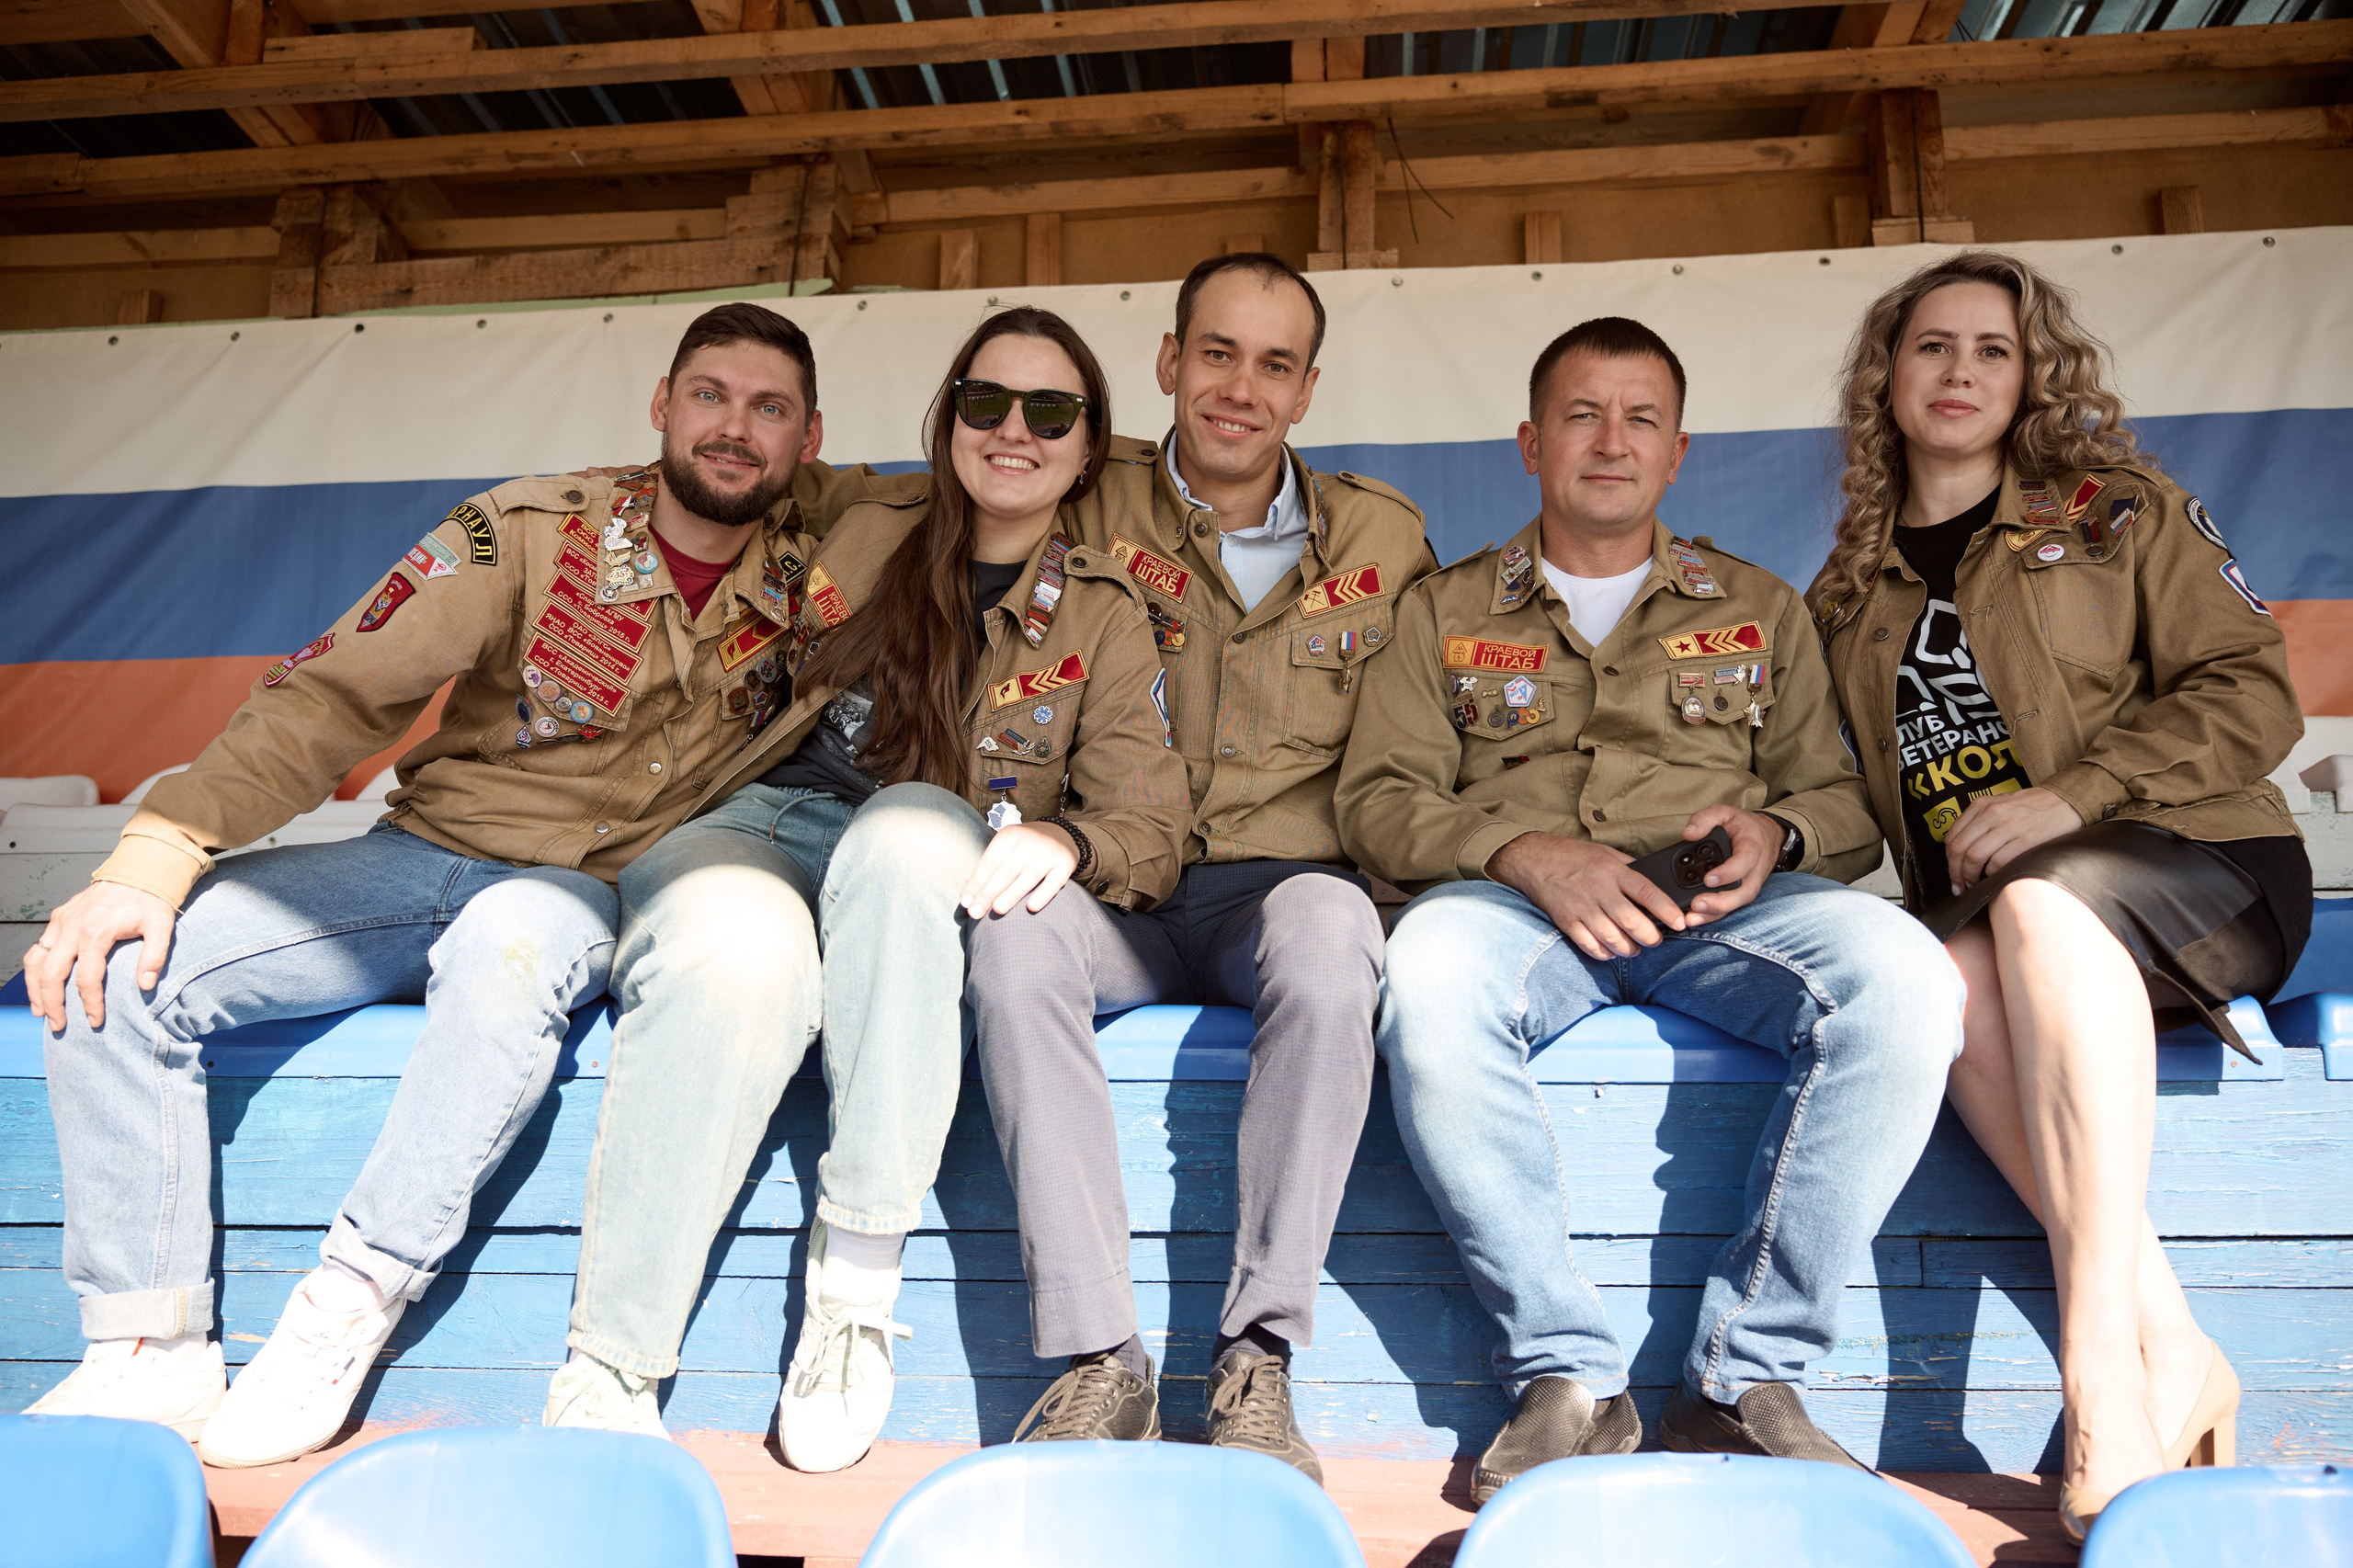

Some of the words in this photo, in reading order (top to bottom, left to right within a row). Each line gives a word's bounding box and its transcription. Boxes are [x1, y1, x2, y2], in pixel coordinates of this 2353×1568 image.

[448, 506, 493, 556] АРНАУЛ
[566, 548, 579, 559] ВСС
[1141, 554, 1181, 580] КРАЕВОЙ
[564, 562, 580, 575] ССО
[580, 574, 597, 586] «Тов
[1134, 562, 1178, 593] ШТАБ
[557, 590, 574, 604] ССО
[574, 603, 608, 629] «Товарищ»
[608, 626, 625, 639] 2015
[584, 603, 615, 625] Бобровка
[605, 608, 625, 621] АГМУ
[816, 596, 840, 626] ШТА
[545, 612, 566, 628] ЯНАО
[567, 627, 583, 639] ВСС
[583, 638, 631, 671] «Бованенково»
[573, 621, 588, 634] ОАО
[548, 623, 564, 635] ССО
[563, 634, 599, 659] «Товарищ»
[599, 656, 617, 669] 2014
[1480, 653, 1535, 669] ШТАБ
[1483, 644, 1537, 658] КРАЕВОЙ
[534, 654, 550, 667] ССО
[550, 666, 587, 691] «Товарищ»
[587, 688, 605, 702] 2013
[541, 642, 558, 655] ВСС
[558, 654, 617, 694] «Академический»
[555, 660, 602, 692] Екатеринбург
[1895, 714, 1945, 746] ЛУБ
[1899, 721, 2009, 772] ЕТЕРАНО
[1908, 739, 2023, 801] «КОЛ
